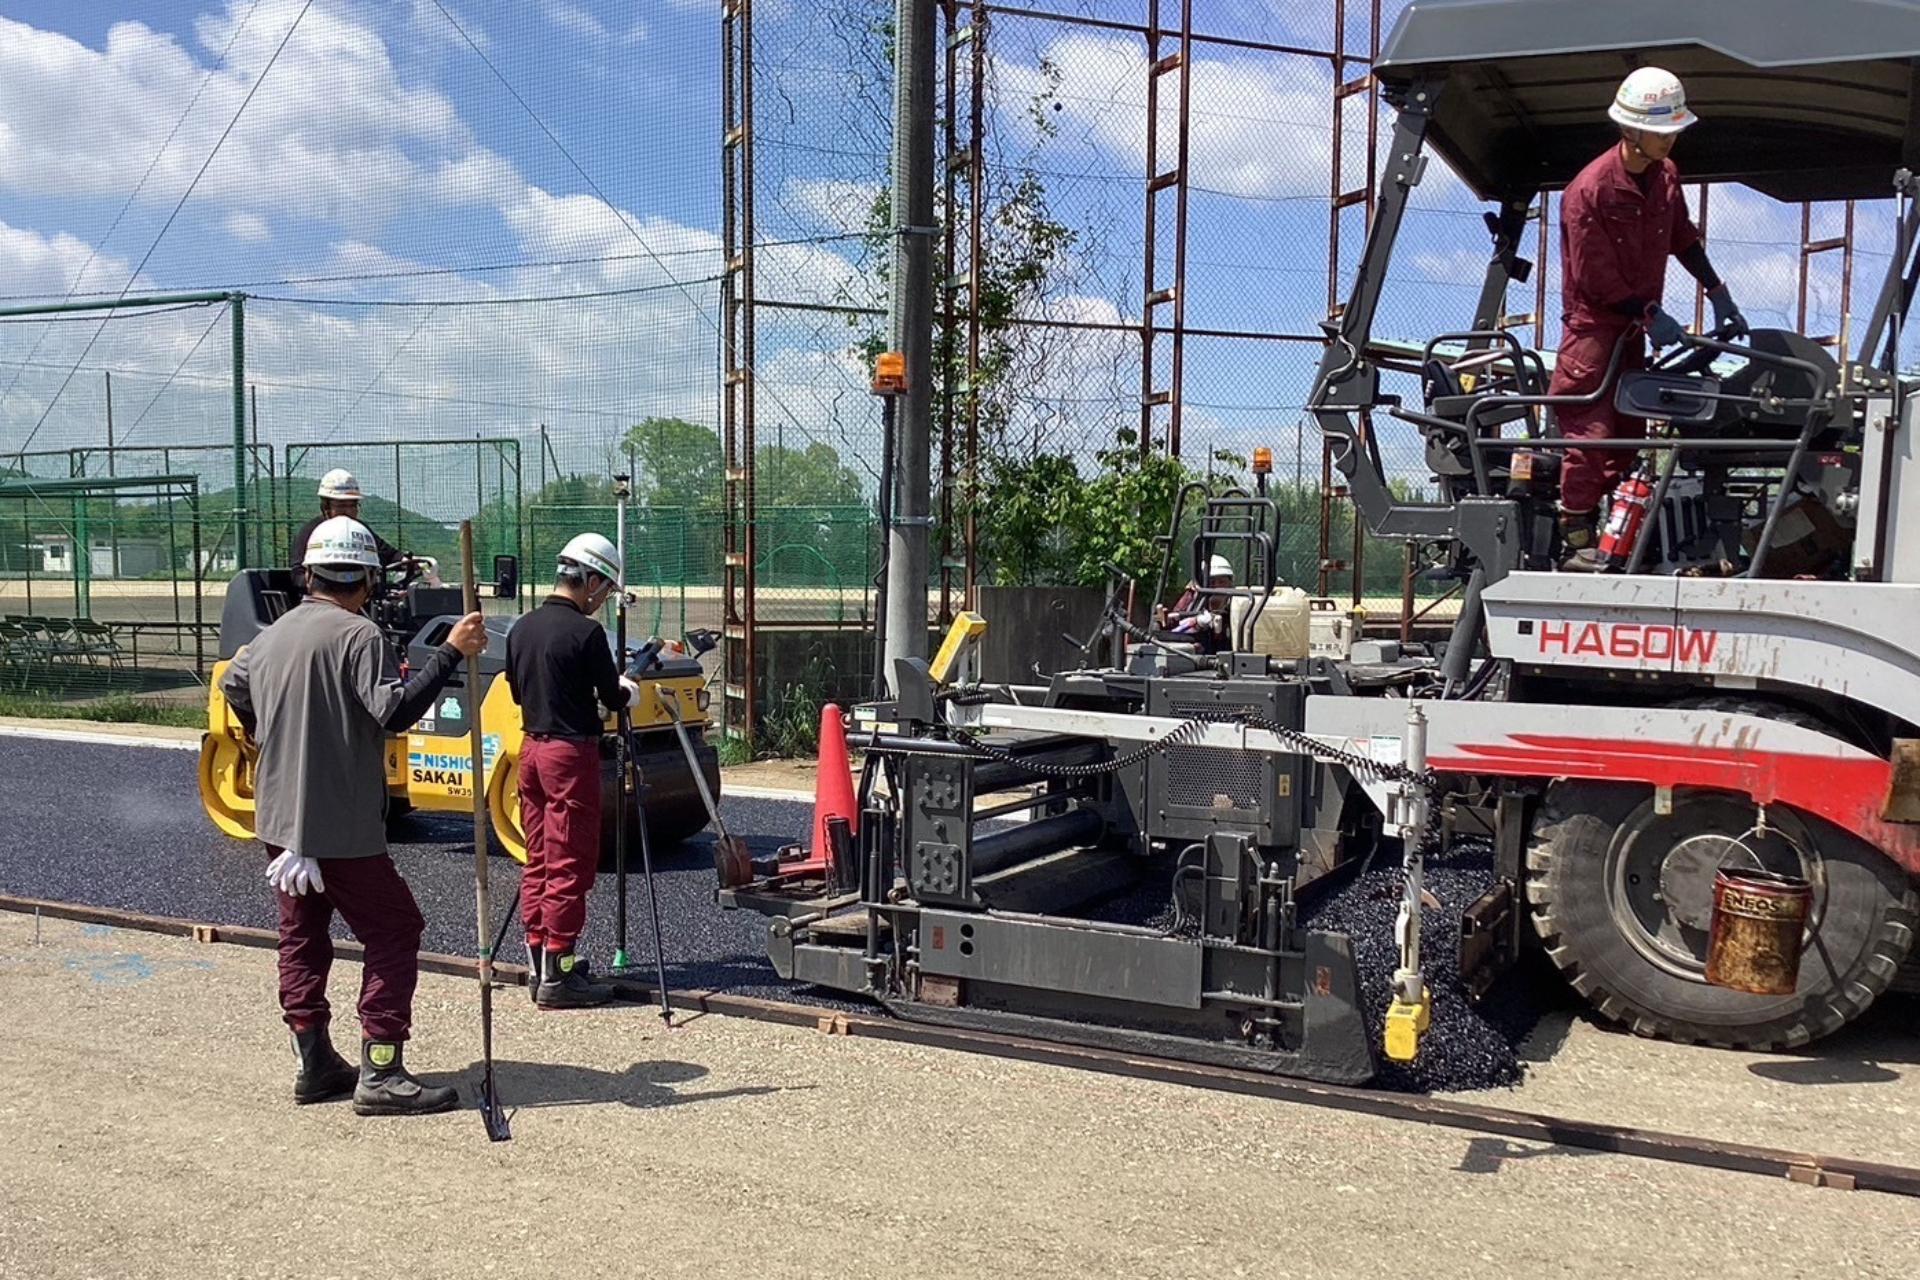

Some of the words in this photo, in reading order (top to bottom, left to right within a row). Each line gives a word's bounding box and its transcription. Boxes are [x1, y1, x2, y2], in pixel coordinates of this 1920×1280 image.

[1539, 621, 1718, 663] HA60W
[412, 769, 463, 786] SAKAI
[1724, 892, 1780, 912] ENEOS
